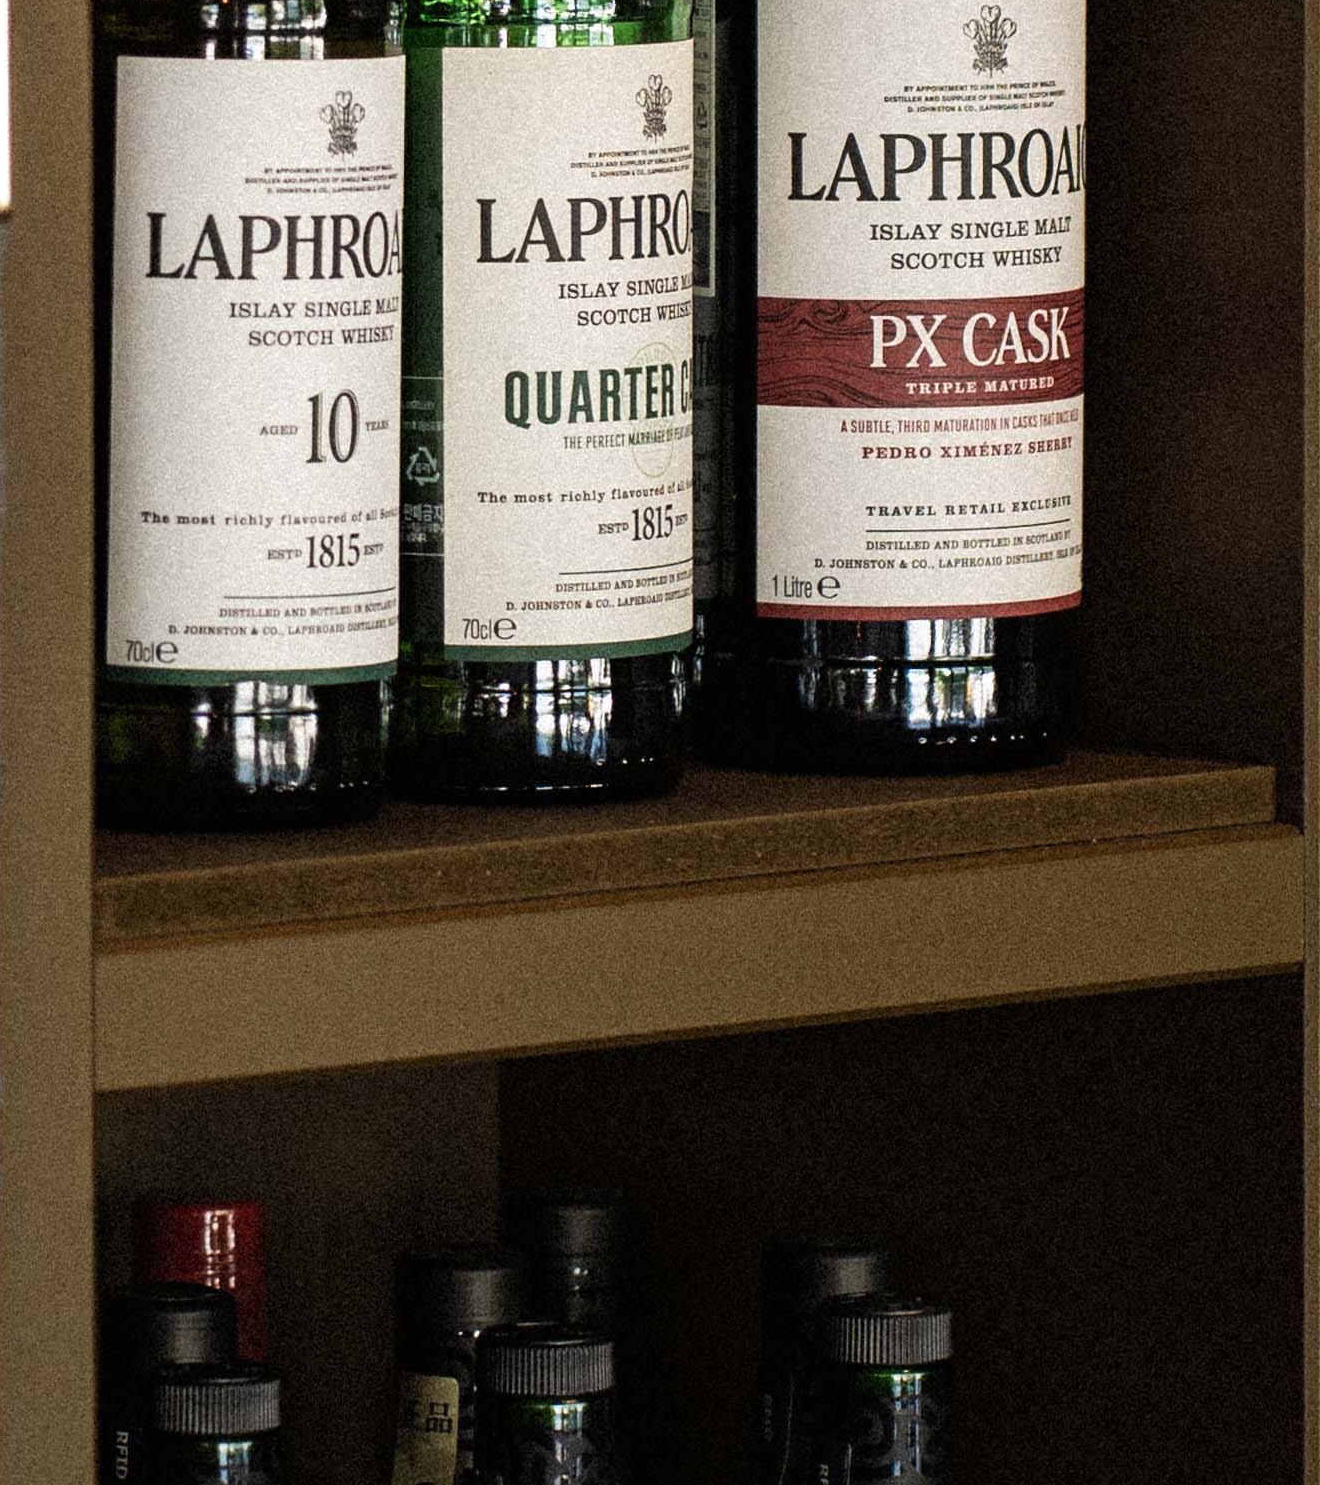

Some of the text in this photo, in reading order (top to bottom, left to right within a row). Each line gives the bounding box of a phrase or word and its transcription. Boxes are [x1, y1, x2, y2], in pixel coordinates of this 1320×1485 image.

[476, 189, 692, 263] LAPHRO
[870, 216, 1072, 241] ISLAY SINGLE MALT
[890, 246, 1063, 270] SCOTCH WHISKY
[558, 277, 679, 299] ISLAY SINGLE
[230, 300, 371, 318] ISLAY SINGLE
[577, 307, 651, 326] SCOTCH
[248, 325, 394, 346] SCOTCH WHISKY
[870, 307, 1070, 368] PX CASK
[505, 362, 674, 429] QUARTER
[906, 376, 1055, 395] TRIPLE MATURED
[259, 389, 360, 464] AGED 10
[840, 413, 1038, 435] A SUBTLE, THIRD MATURATION IN CASKS
[564, 431, 665, 449] THE PERFECT MARRIAGE
[862, 436, 1073, 459] PEDRO XIMÉNEZ SHERRY
[477, 484, 665, 503] The most richly flavoured
[866, 495, 1071, 517] TRAVEL RETAIL EXCLUSIVE
[141, 510, 362, 528] The most richly flavoured of
[598, 504, 674, 542] ESTD 1815
[267, 533, 360, 569] ESTD 1815
[866, 536, 1023, 551] DISTILLED AND BOTTLED IN
[814, 555, 1003, 569] D. JOHNSTON & LAPHROAIG
[556, 577, 667, 593] DISTILLED AND BOTTLED
[783, 575, 813, 598] Litre
[219, 606, 352, 618] DISTILLED AND BOTTLED
[521, 593, 664, 611] JOHNSTON & LAPHROAIG
[183, 625, 247, 635] JOHNSTON
[115, 1430, 129, 1480] RFID
